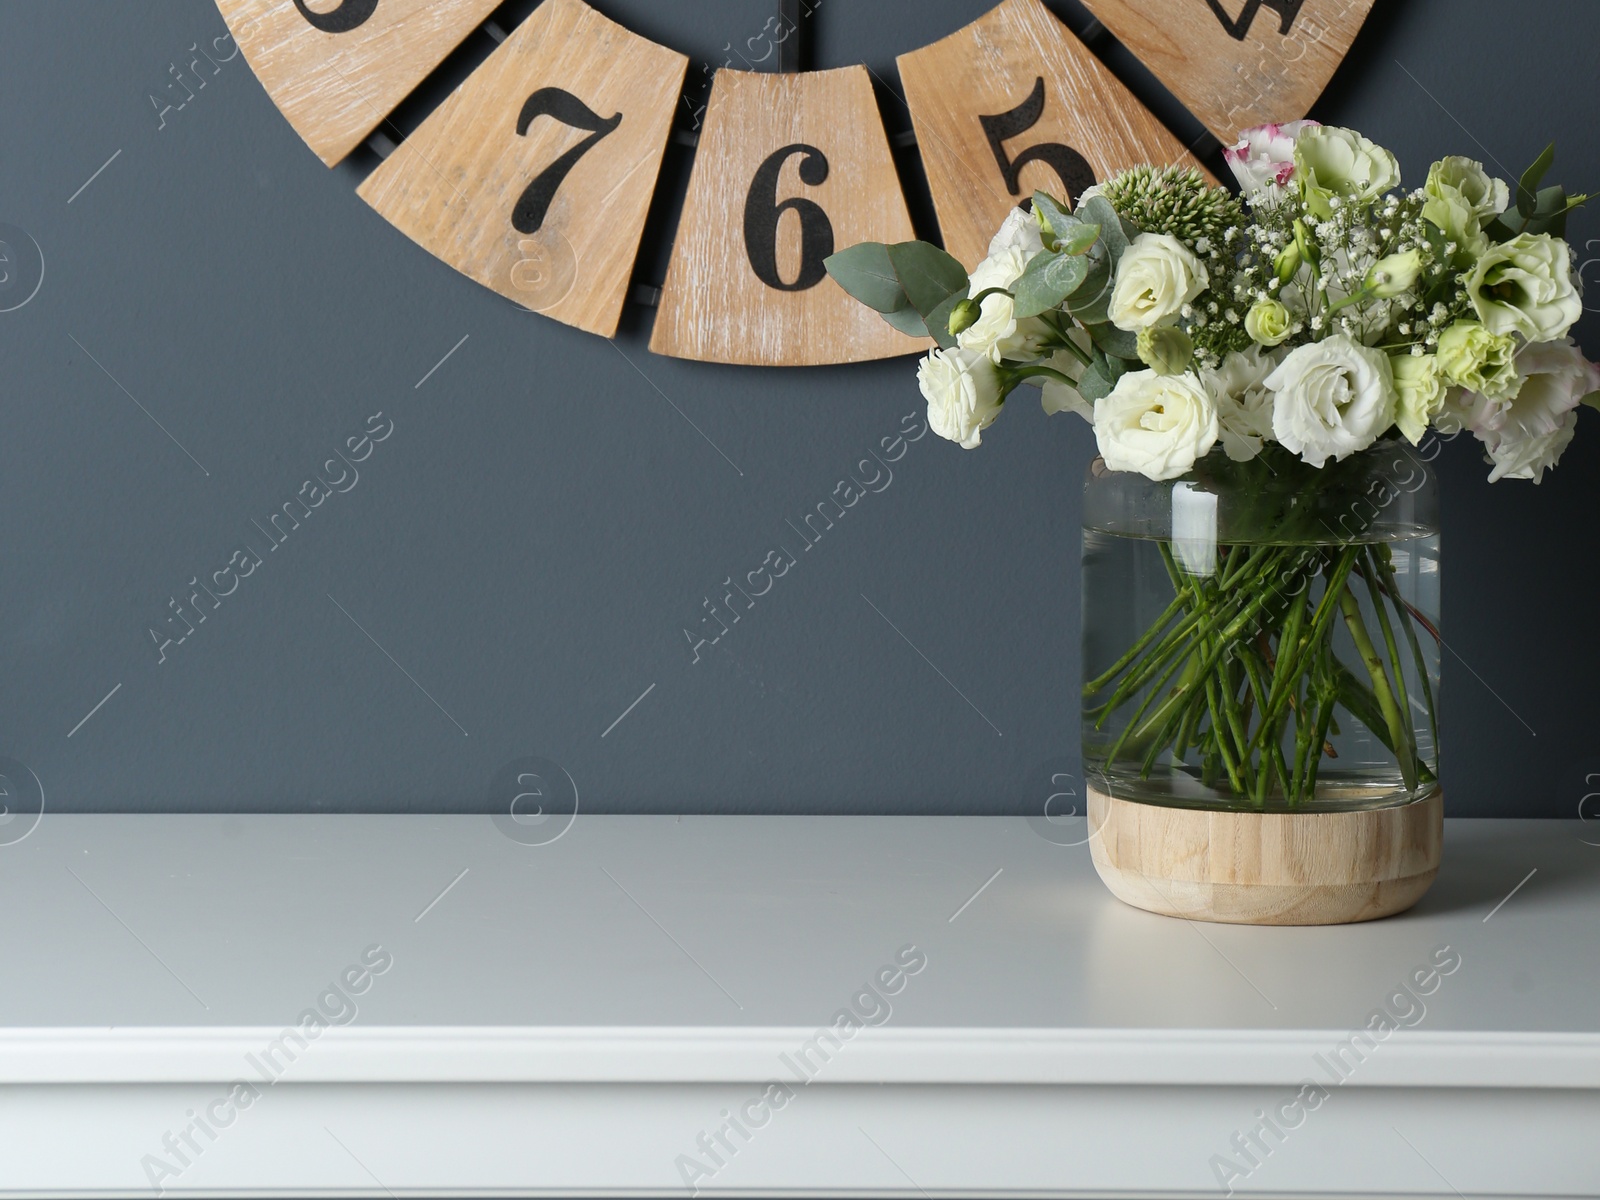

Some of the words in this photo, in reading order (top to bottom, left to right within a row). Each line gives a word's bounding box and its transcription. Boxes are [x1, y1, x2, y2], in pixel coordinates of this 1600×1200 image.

[512, 87, 622, 234] 7
[744, 143, 834, 291] 6
[979, 76, 1097, 215] 5
